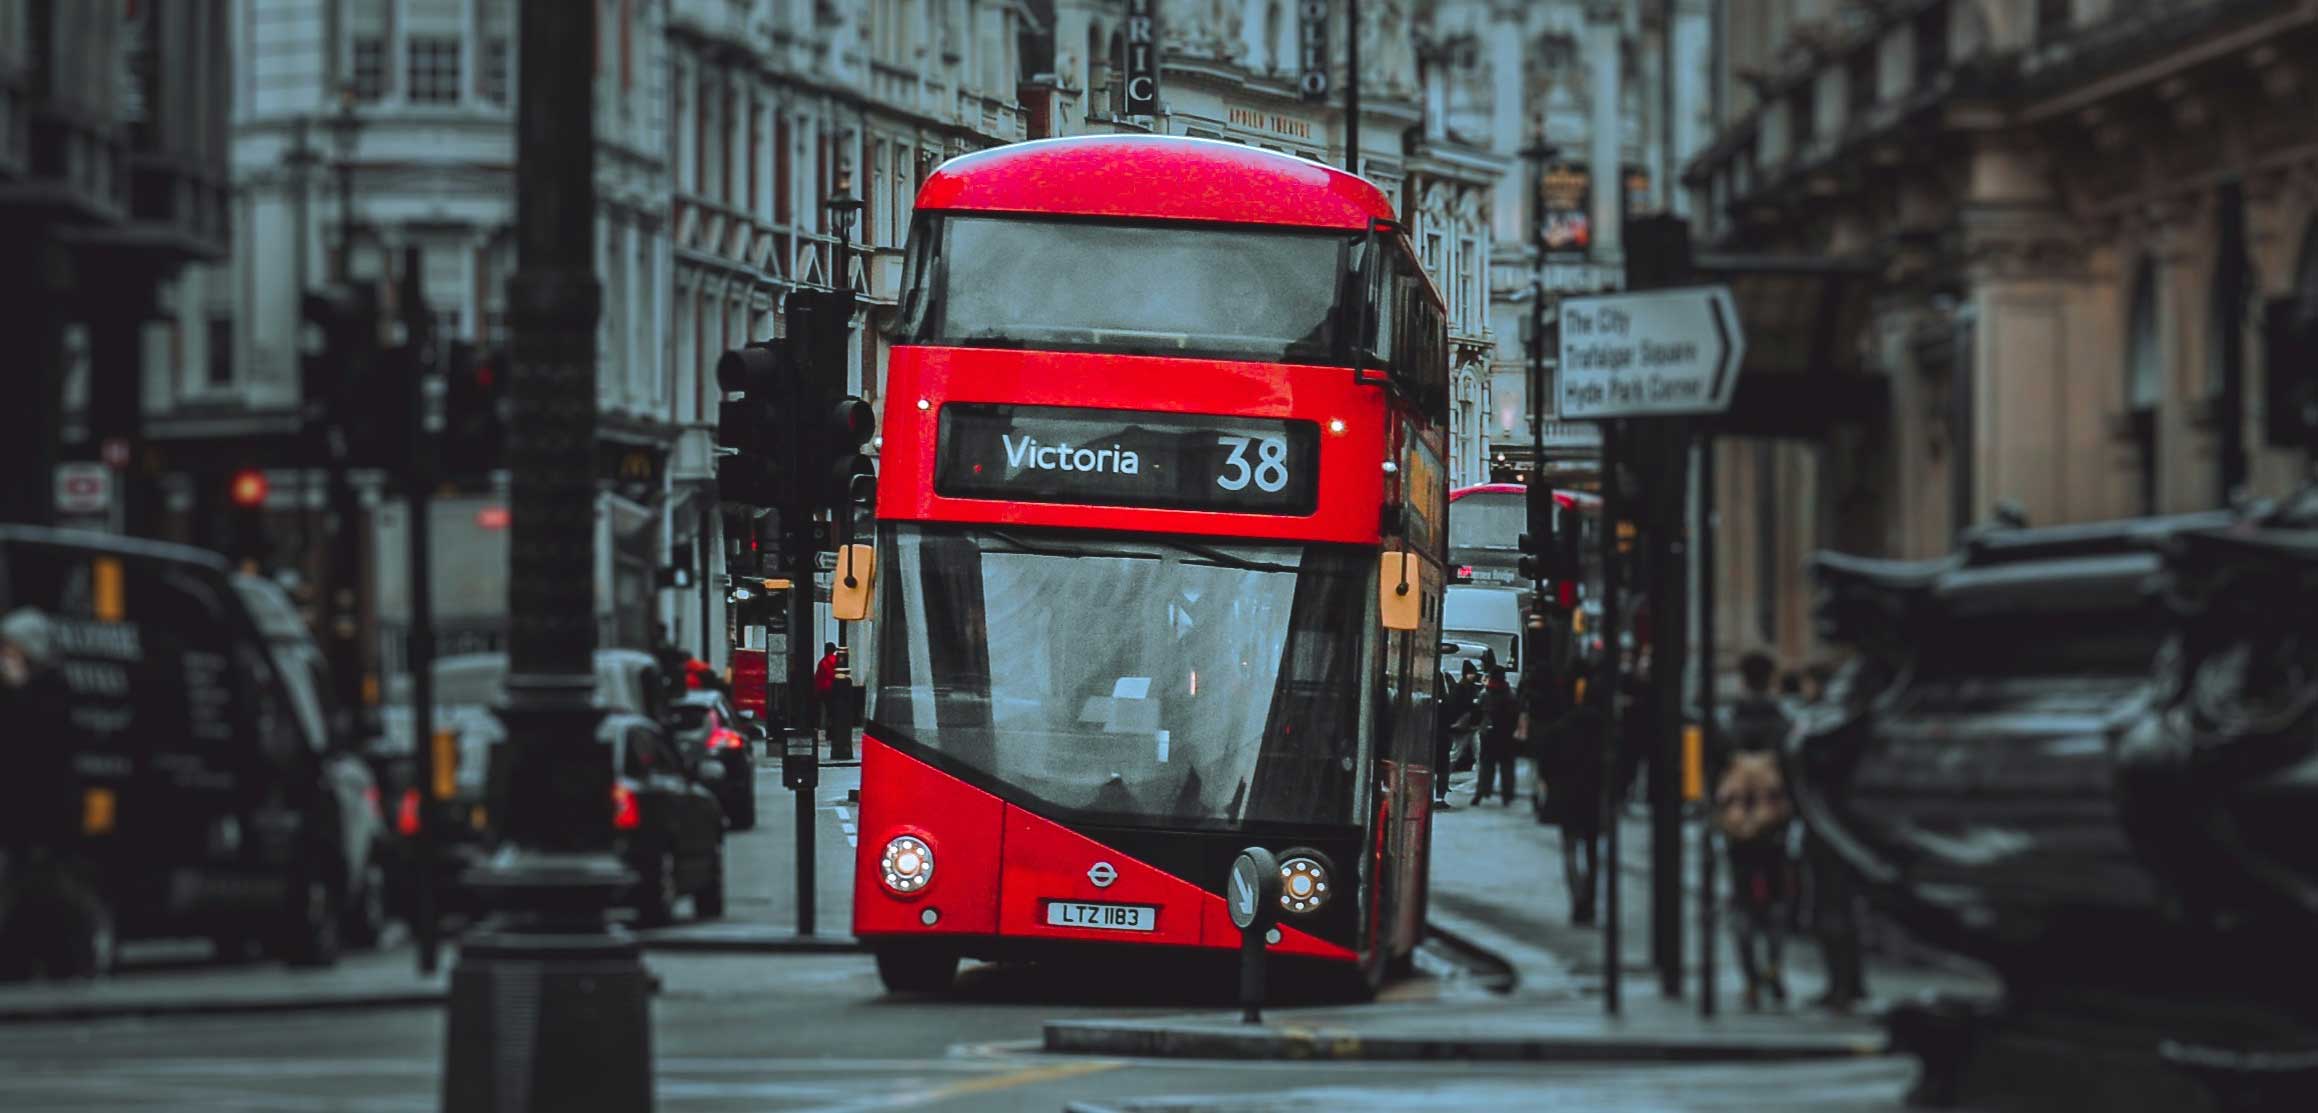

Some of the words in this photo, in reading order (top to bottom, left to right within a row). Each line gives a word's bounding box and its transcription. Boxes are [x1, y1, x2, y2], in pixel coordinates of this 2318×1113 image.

[1566, 309, 1592, 335] The
[1597, 306, 1630, 339] City
[1566, 343, 1634, 371] Trafalgar
[1639, 338, 1697, 369] Square
[1566, 379, 1602, 411] Hyde
[1607, 376, 1643, 403] Park
[1648, 373, 1702, 401] Corner
[1001, 433, 1139, 475] Victoria
[1216, 435, 1289, 493] 38
[1062, 904, 1100, 924] LTZ
[1104, 907, 1139, 927] 1183
